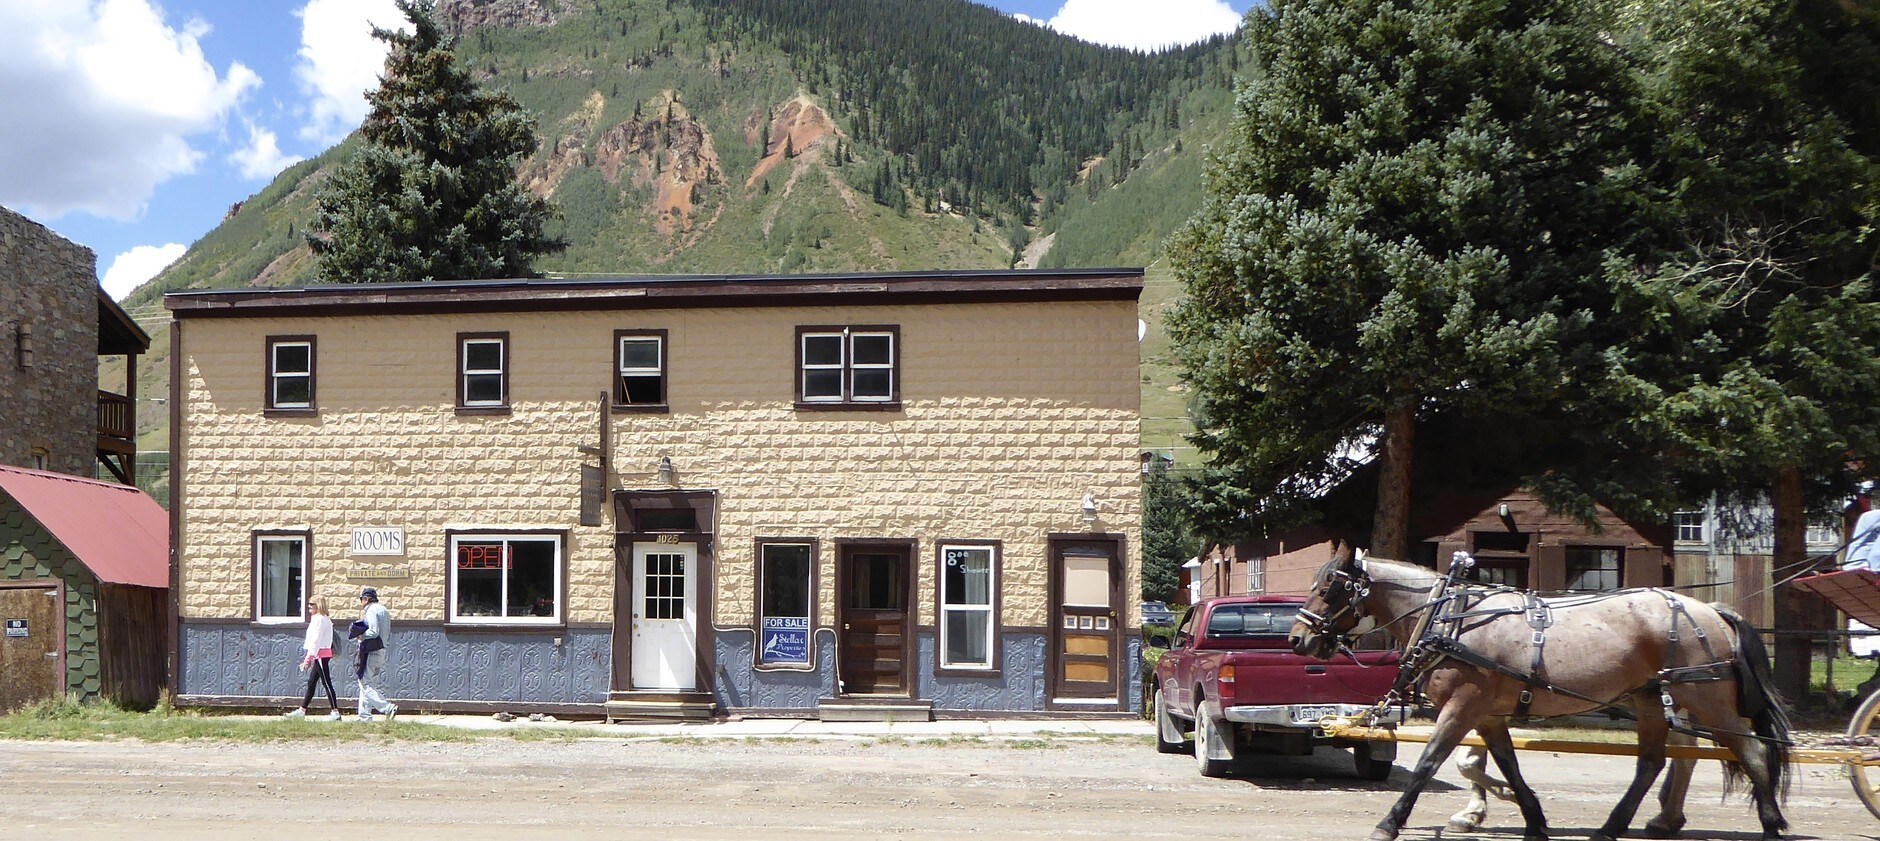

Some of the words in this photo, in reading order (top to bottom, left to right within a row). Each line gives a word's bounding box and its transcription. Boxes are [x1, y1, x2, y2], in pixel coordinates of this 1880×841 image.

[354, 531, 401, 551] ROOMS
[657, 534, 680, 544] 1025
[457, 545, 512, 569] OPEN
[12, 620, 22, 628] NO
[765, 618, 783, 627] FOR
[784, 618, 808, 628] SALE
